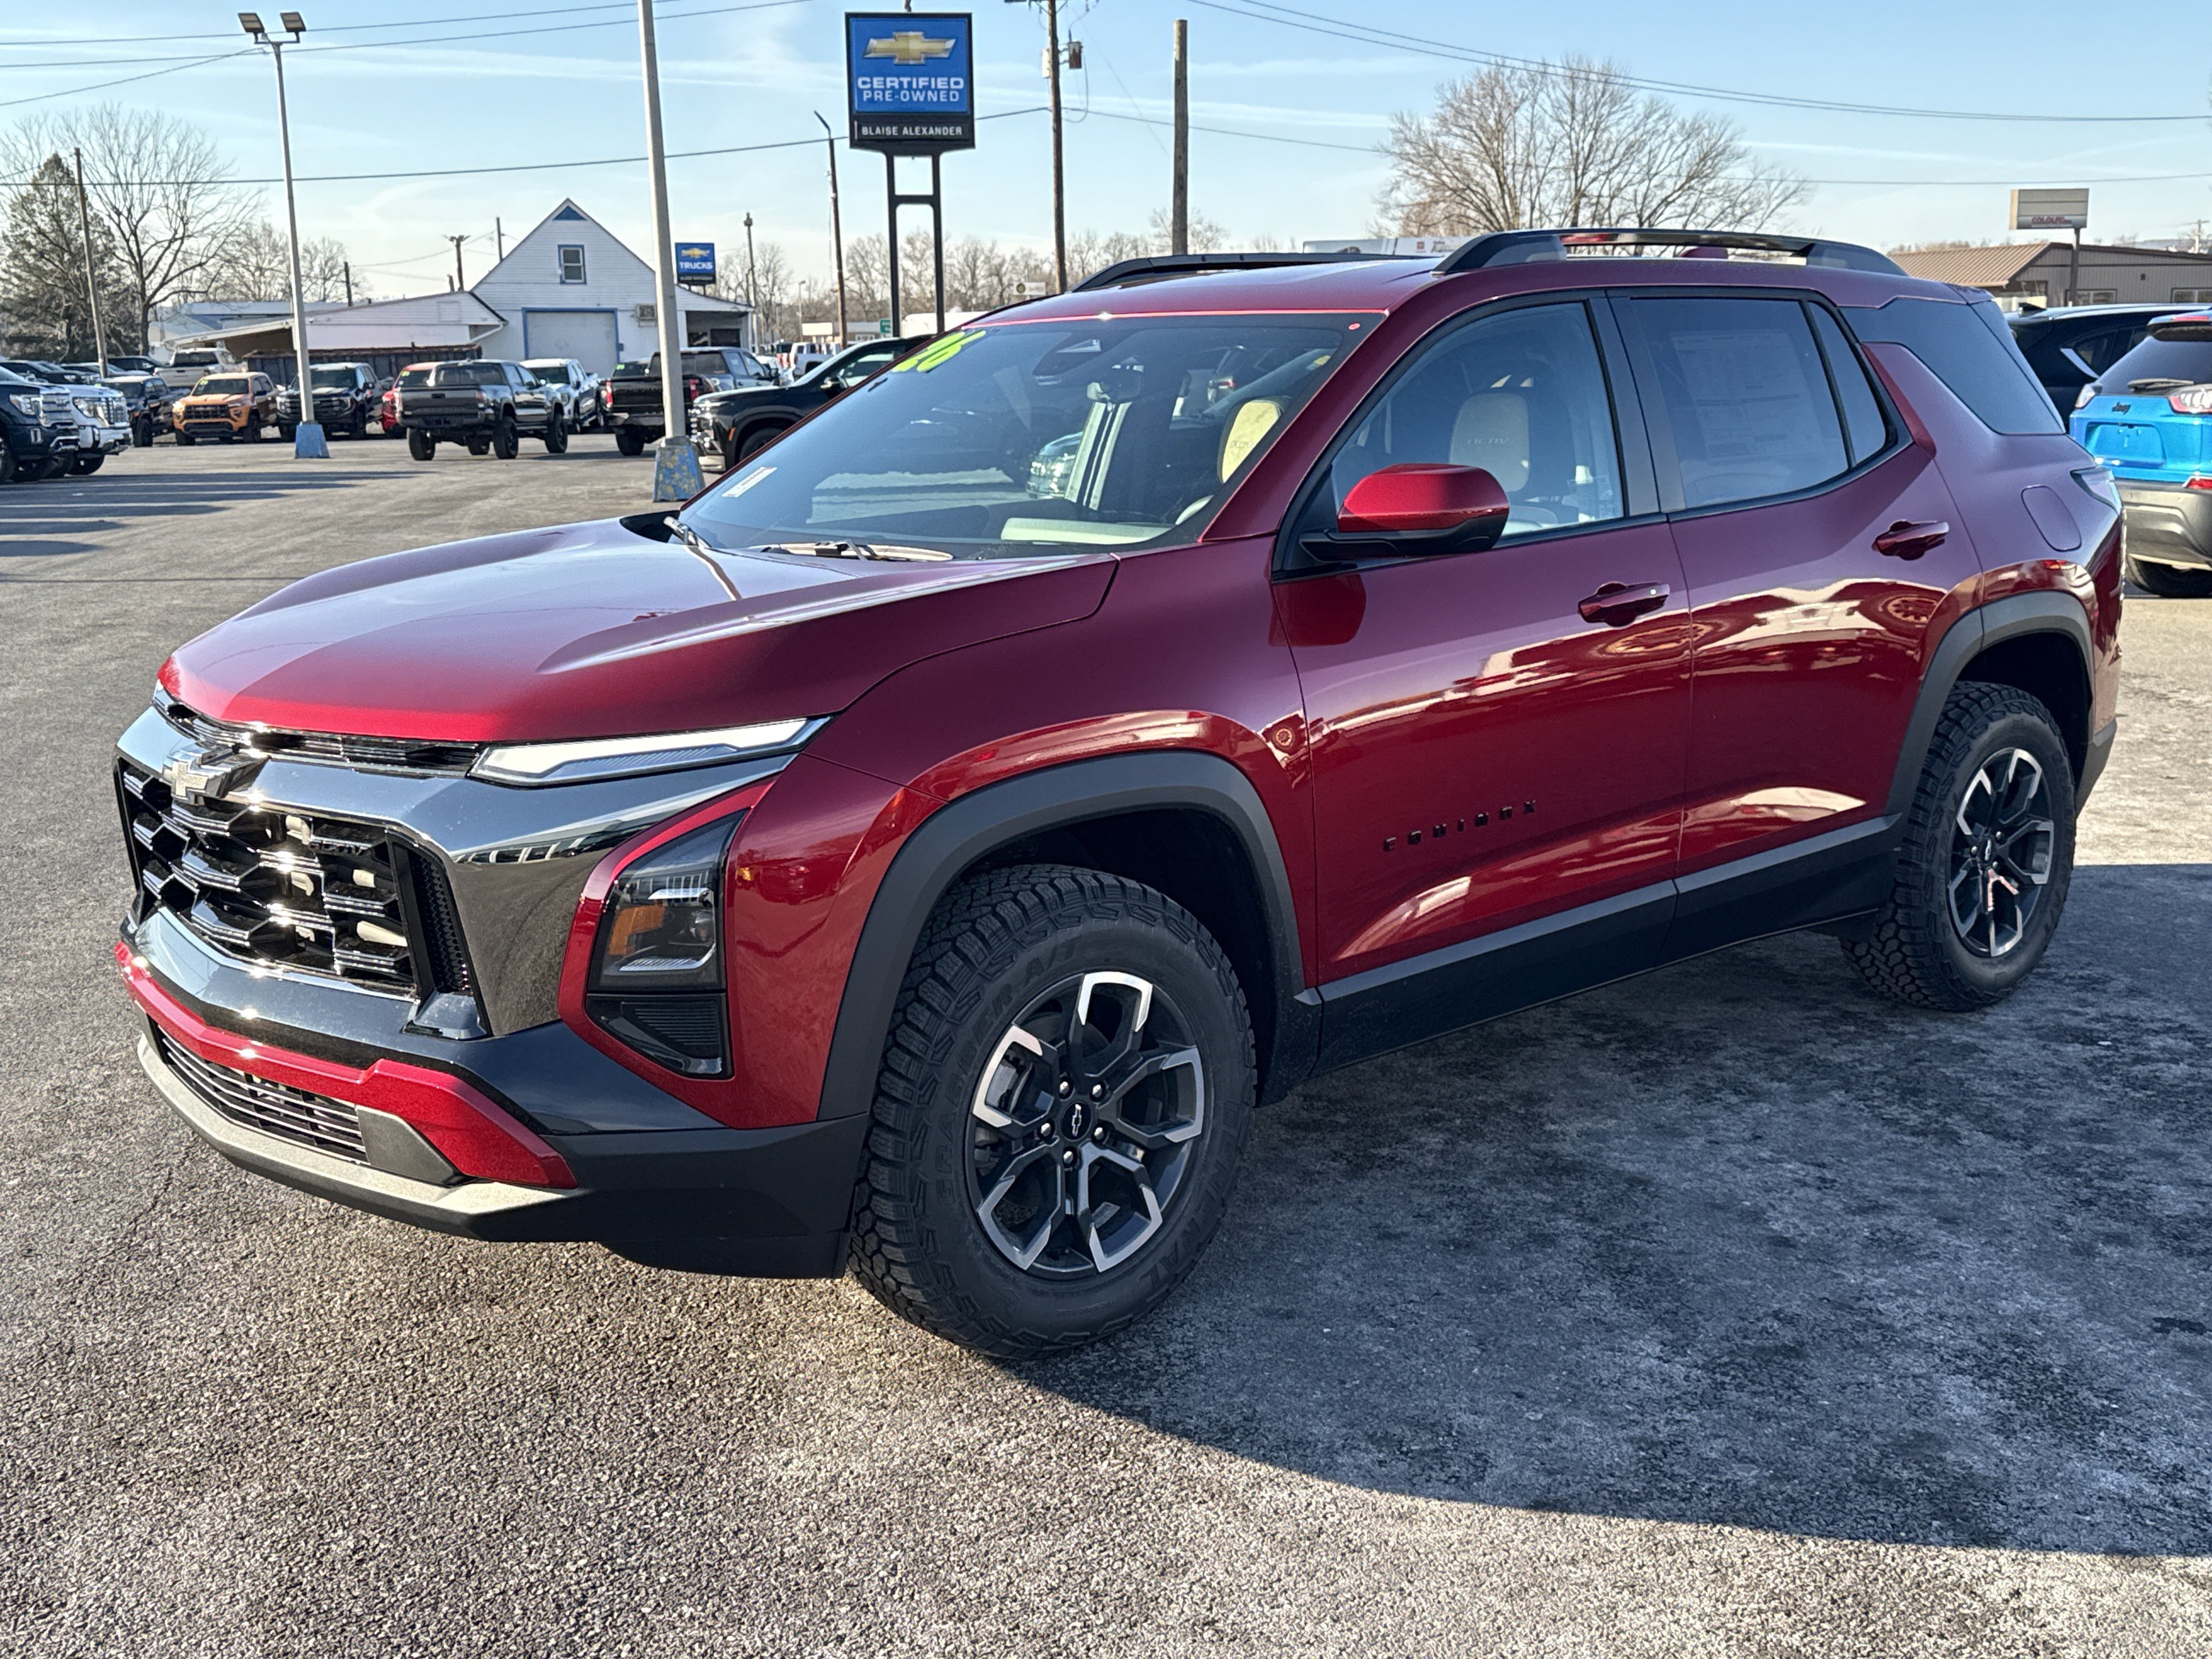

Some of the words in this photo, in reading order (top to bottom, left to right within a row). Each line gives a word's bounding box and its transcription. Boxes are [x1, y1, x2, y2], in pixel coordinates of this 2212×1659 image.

[857, 77, 964, 89] CERTIFIED
[863, 91, 959, 101] PRE-OWNED
[862, 126, 898, 136] BLAISE
[902, 126, 962, 136] ALEXANDER
[1383, 799, 1536, 851] EQUINOX
